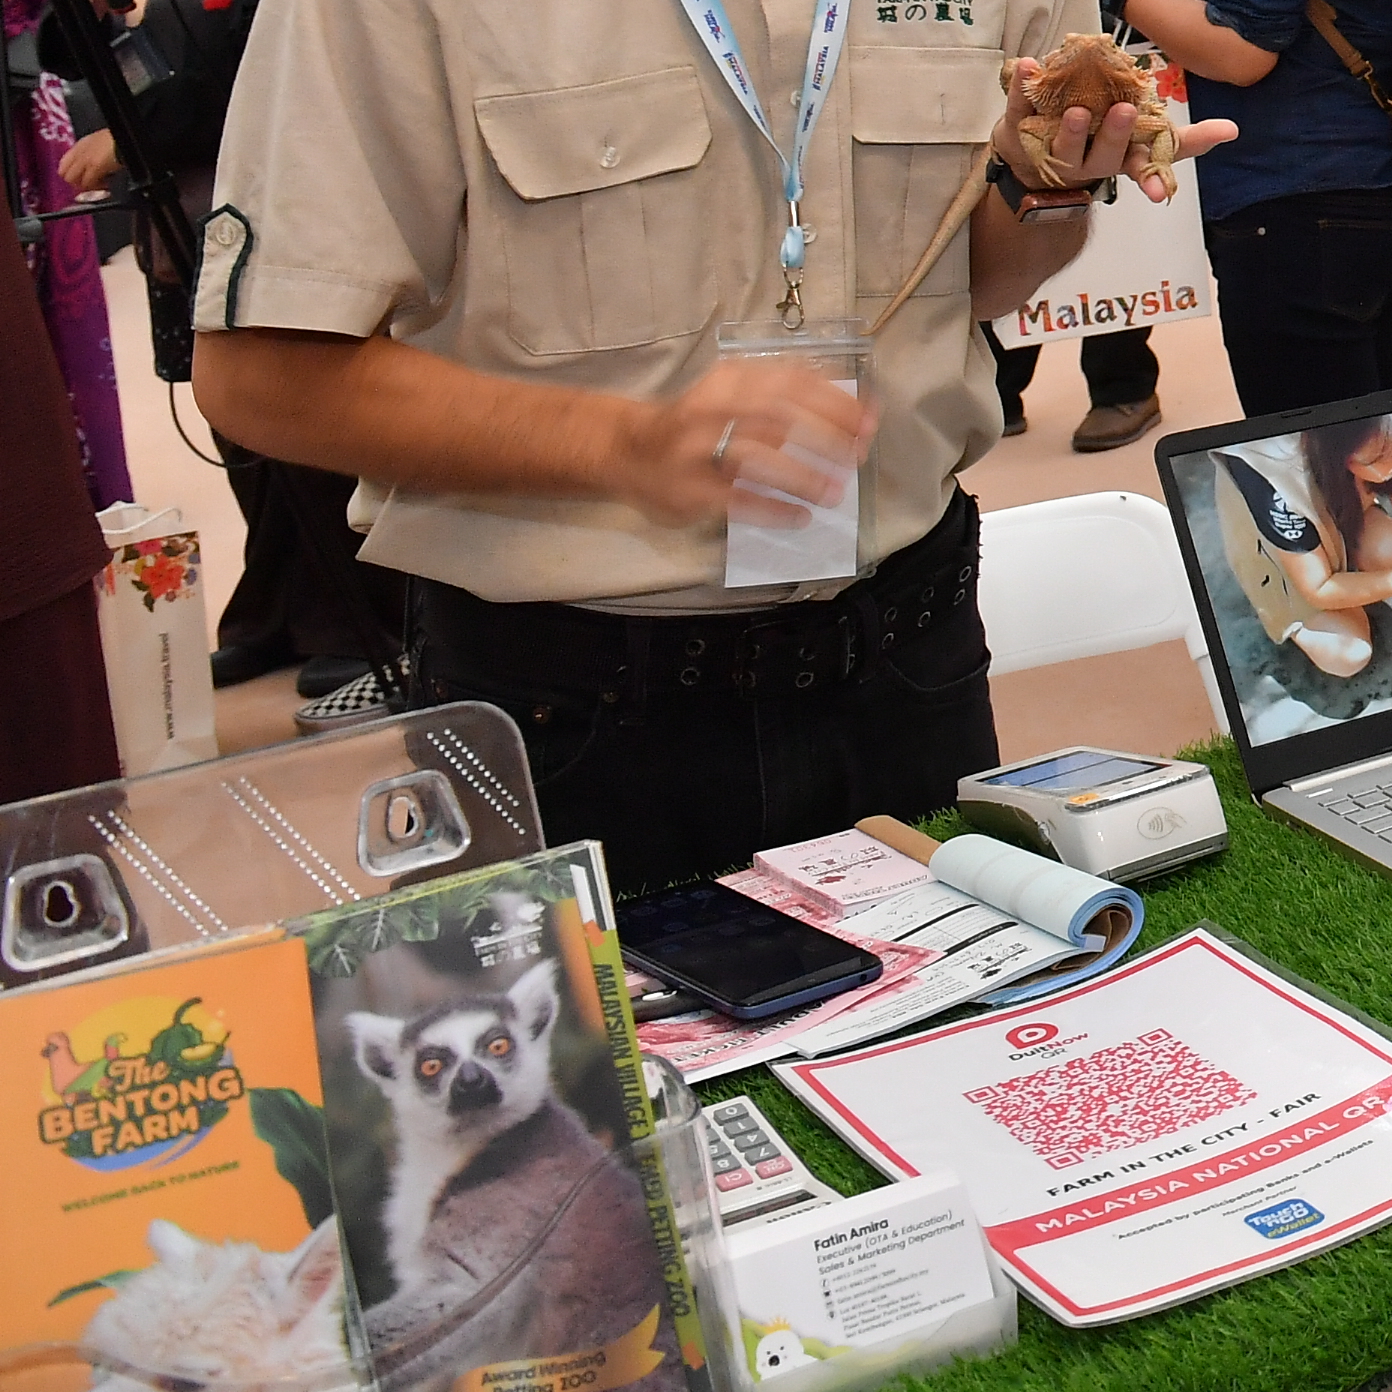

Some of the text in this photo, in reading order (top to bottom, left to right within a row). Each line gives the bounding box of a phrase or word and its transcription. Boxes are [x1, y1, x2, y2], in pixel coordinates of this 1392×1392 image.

[1017, 280, 1198, 336] Malaysia
[1008, 1032, 1089, 1062] DuitNow
[1040, 1047, 1067, 1060] QR
[109, 1059, 170, 1092] The
[43, 1068, 241, 1141] BENTONG
[91, 1106, 199, 1156] FARM
[593, 964, 632, 1060] MALAYSIAN
[617, 1064, 648, 1129] VILLAGE
[649, 1206, 682, 1275] PETTING
[667, 1279, 690, 1317] ZOO
[1046, 1092, 1323, 1198] FARM IN THE CITY FAIR
[62, 1161, 240, 1213] WELCOME BACK TO NATURE
[1034, 1095, 1386, 1234] MALAYSIA NATIONAL QR
[1174, 1139, 1373, 1222] by participating Banks and e-Wallets
[1249, 1202, 1304, 1226] Touch
[1264, 1185, 1297, 1202] Partner
[814, 1219, 889, 1251] Fatin Amira
[816, 1210, 953, 1264] Executive (OTA & Education)
[818, 1219, 965, 1275] Sales & Marketing Department
[1267, 1213, 1320, 1238] eWallet
[481, 1367, 535, 1386] Award
